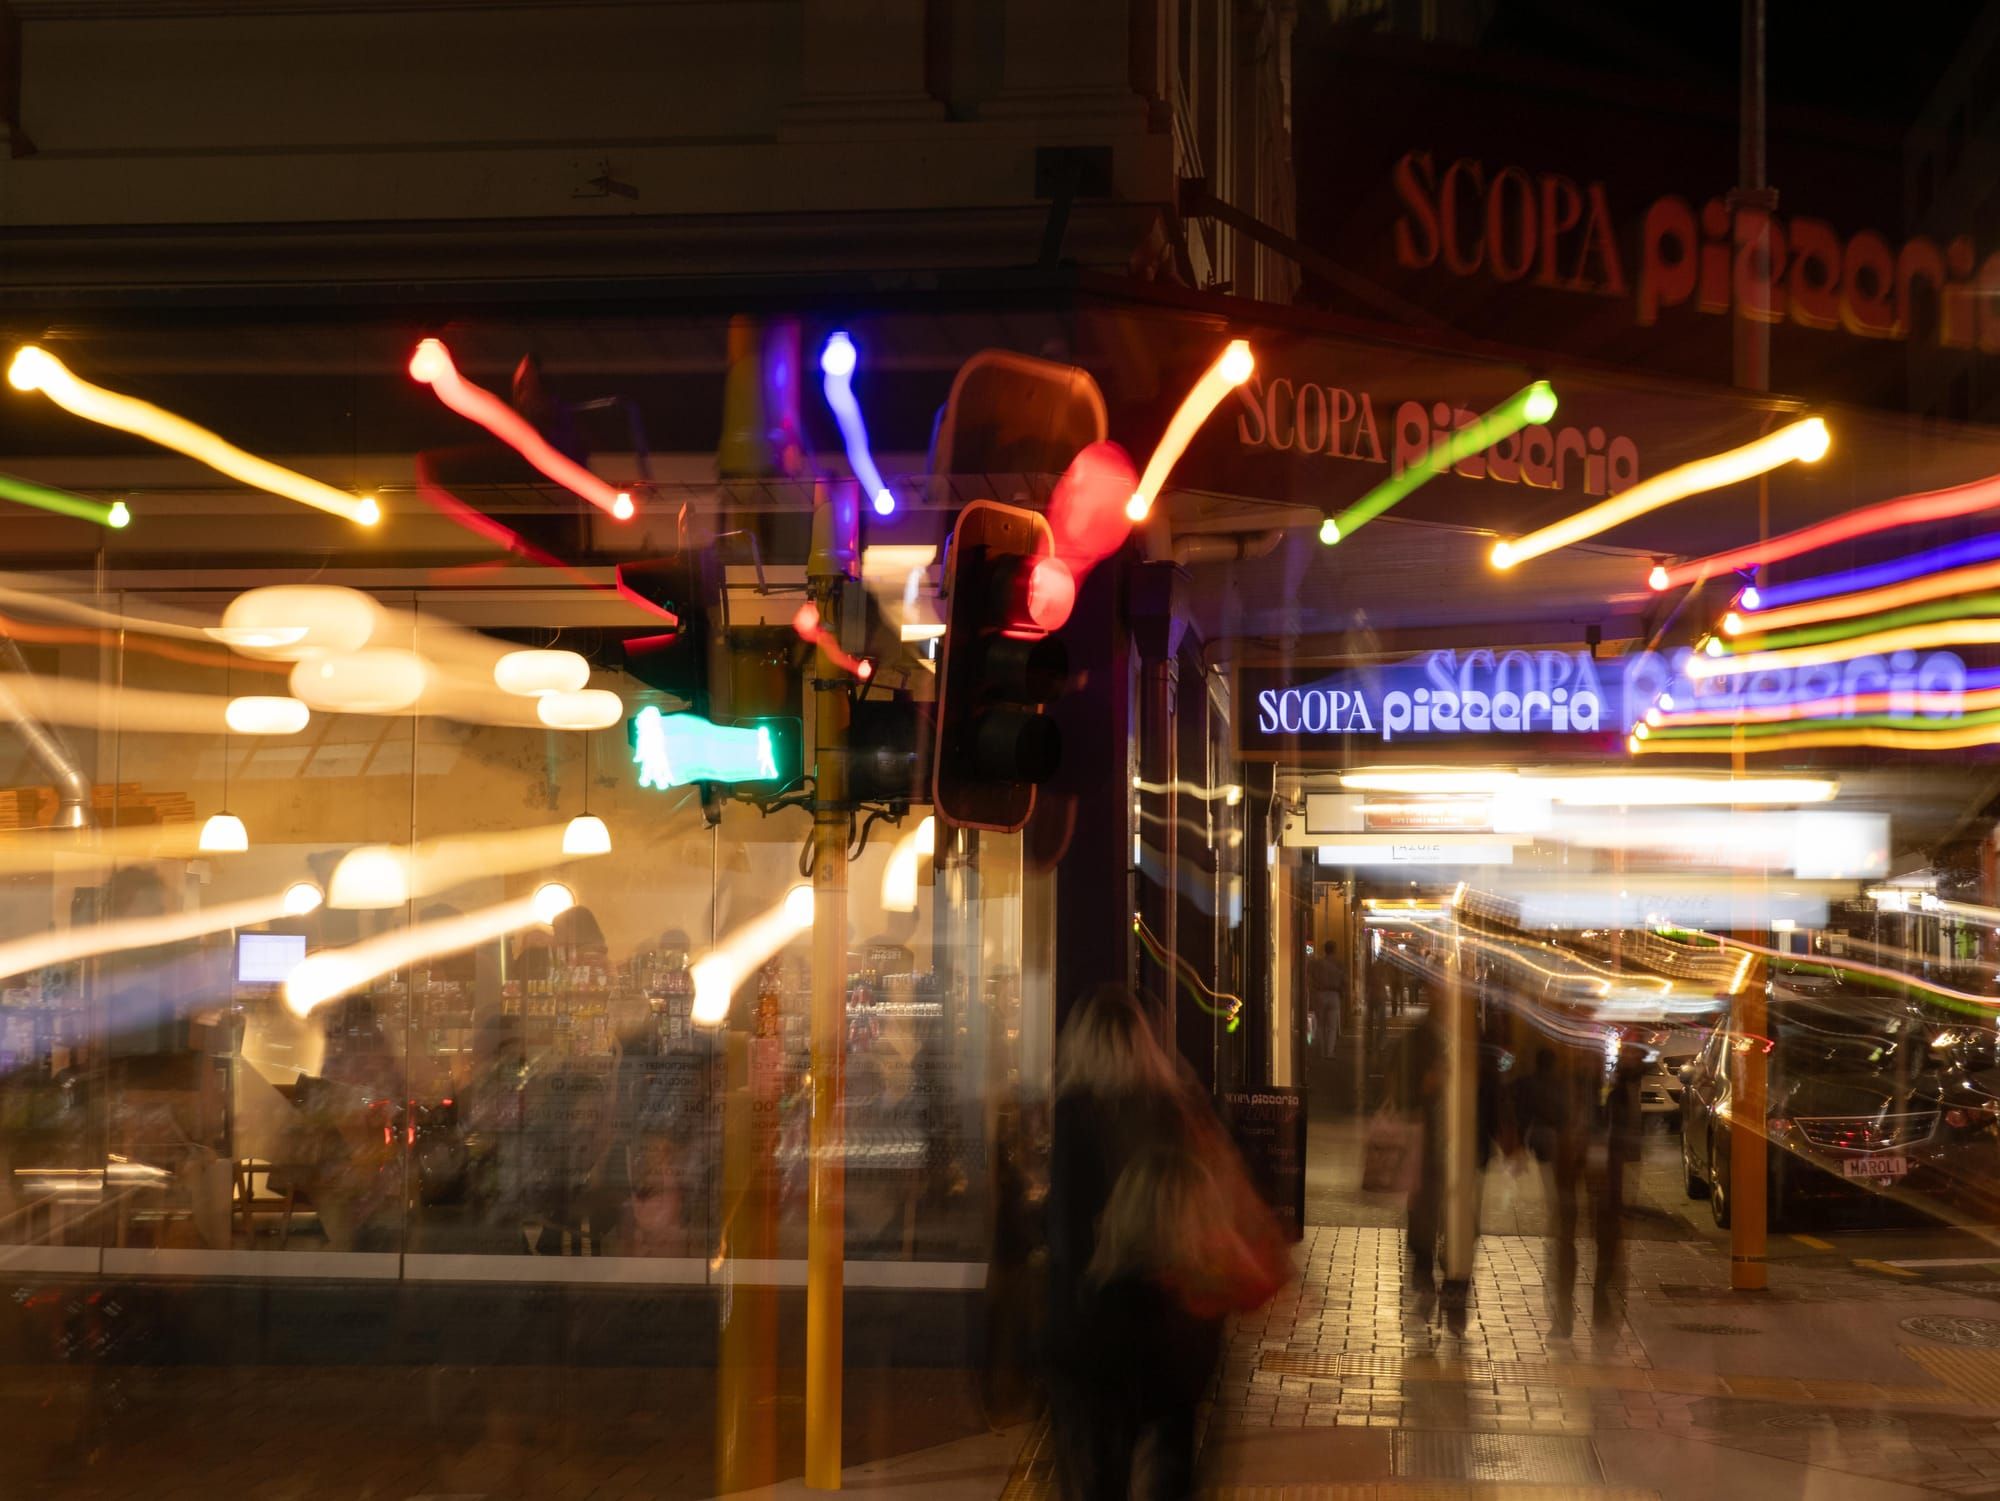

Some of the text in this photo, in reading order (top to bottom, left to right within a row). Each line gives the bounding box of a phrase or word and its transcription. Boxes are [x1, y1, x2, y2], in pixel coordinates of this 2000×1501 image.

[1394, 152, 1629, 298] SCOPA
[1237, 376, 1388, 464] SCOPA
[1258, 687, 1600, 742] SCOPA pizzeria
[1427, 648, 1612, 720] SCOPA
[1850, 1159, 1900, 1174] MAROLI
